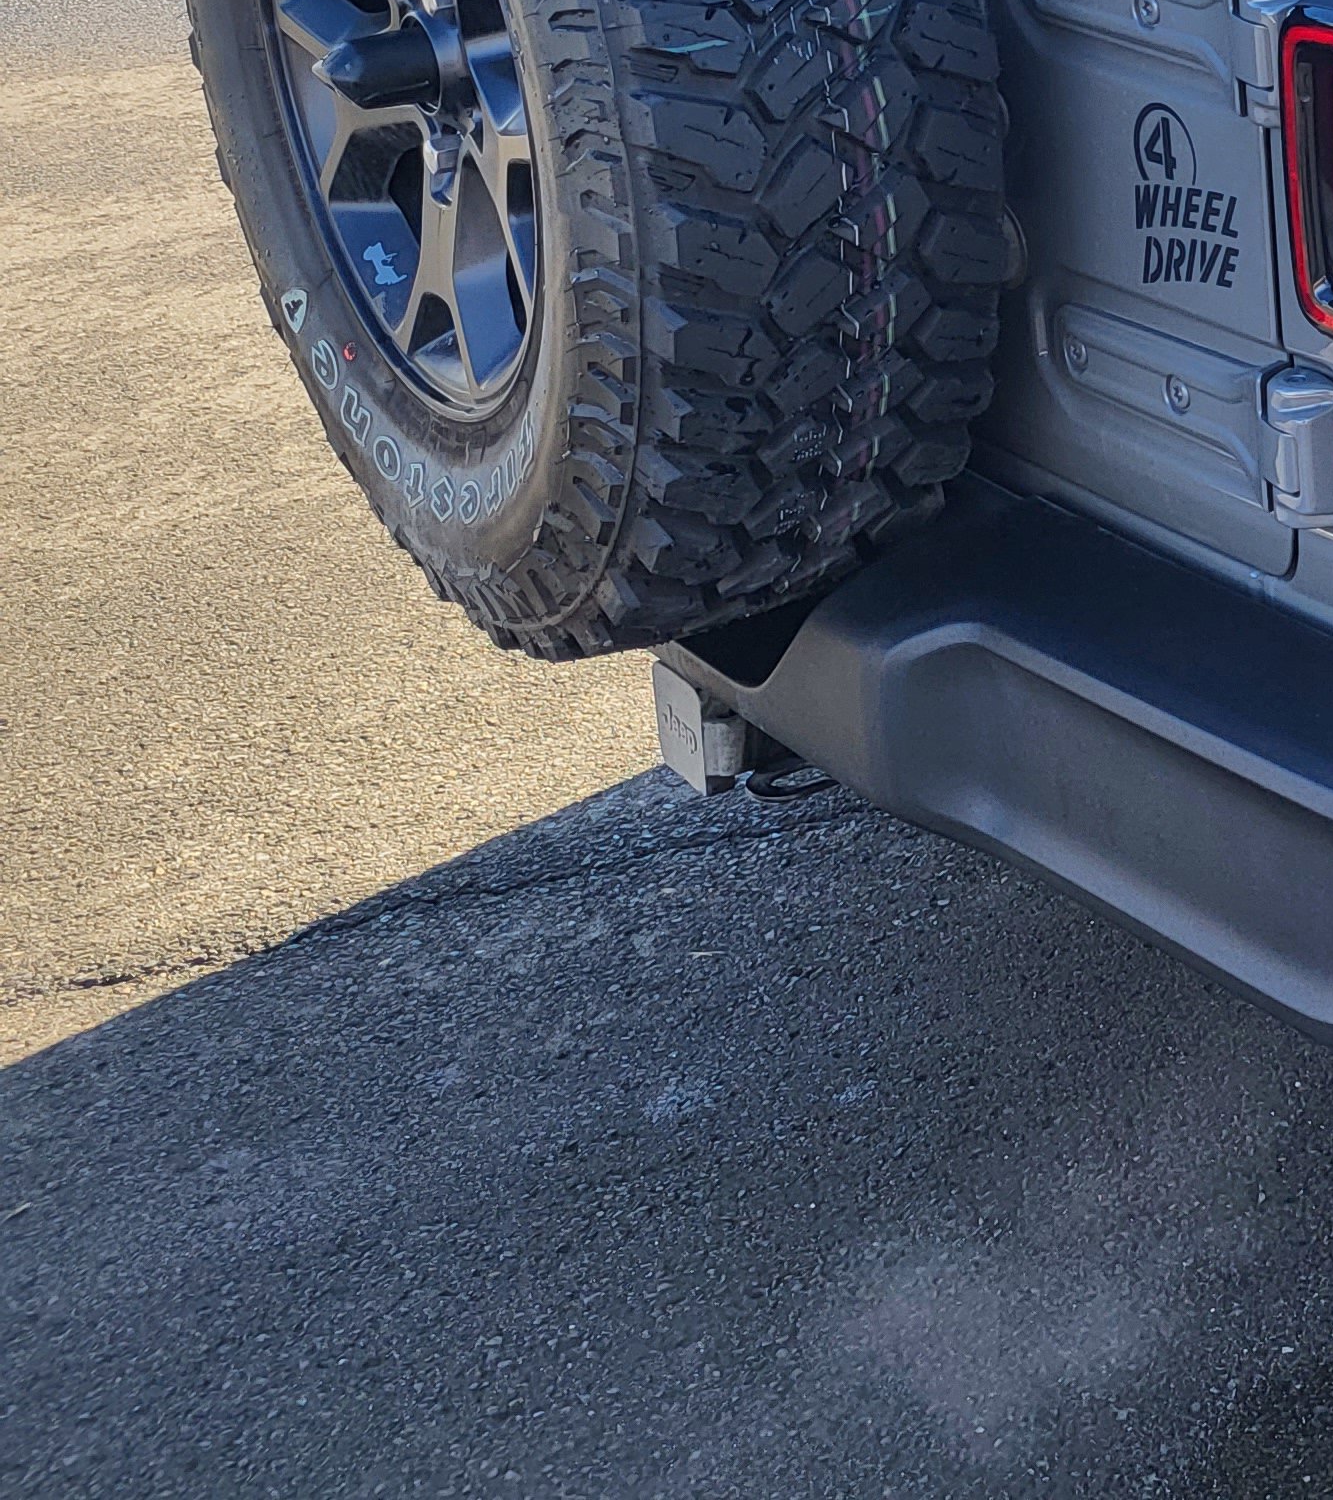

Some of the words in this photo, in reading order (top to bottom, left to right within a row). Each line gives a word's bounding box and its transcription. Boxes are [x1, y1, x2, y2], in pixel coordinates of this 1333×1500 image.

[1143, 116, 1178, 181] 4
[1134, 183, 1240, 239] WHEEL
[1142, 235, 1240, 289] DRIVE
